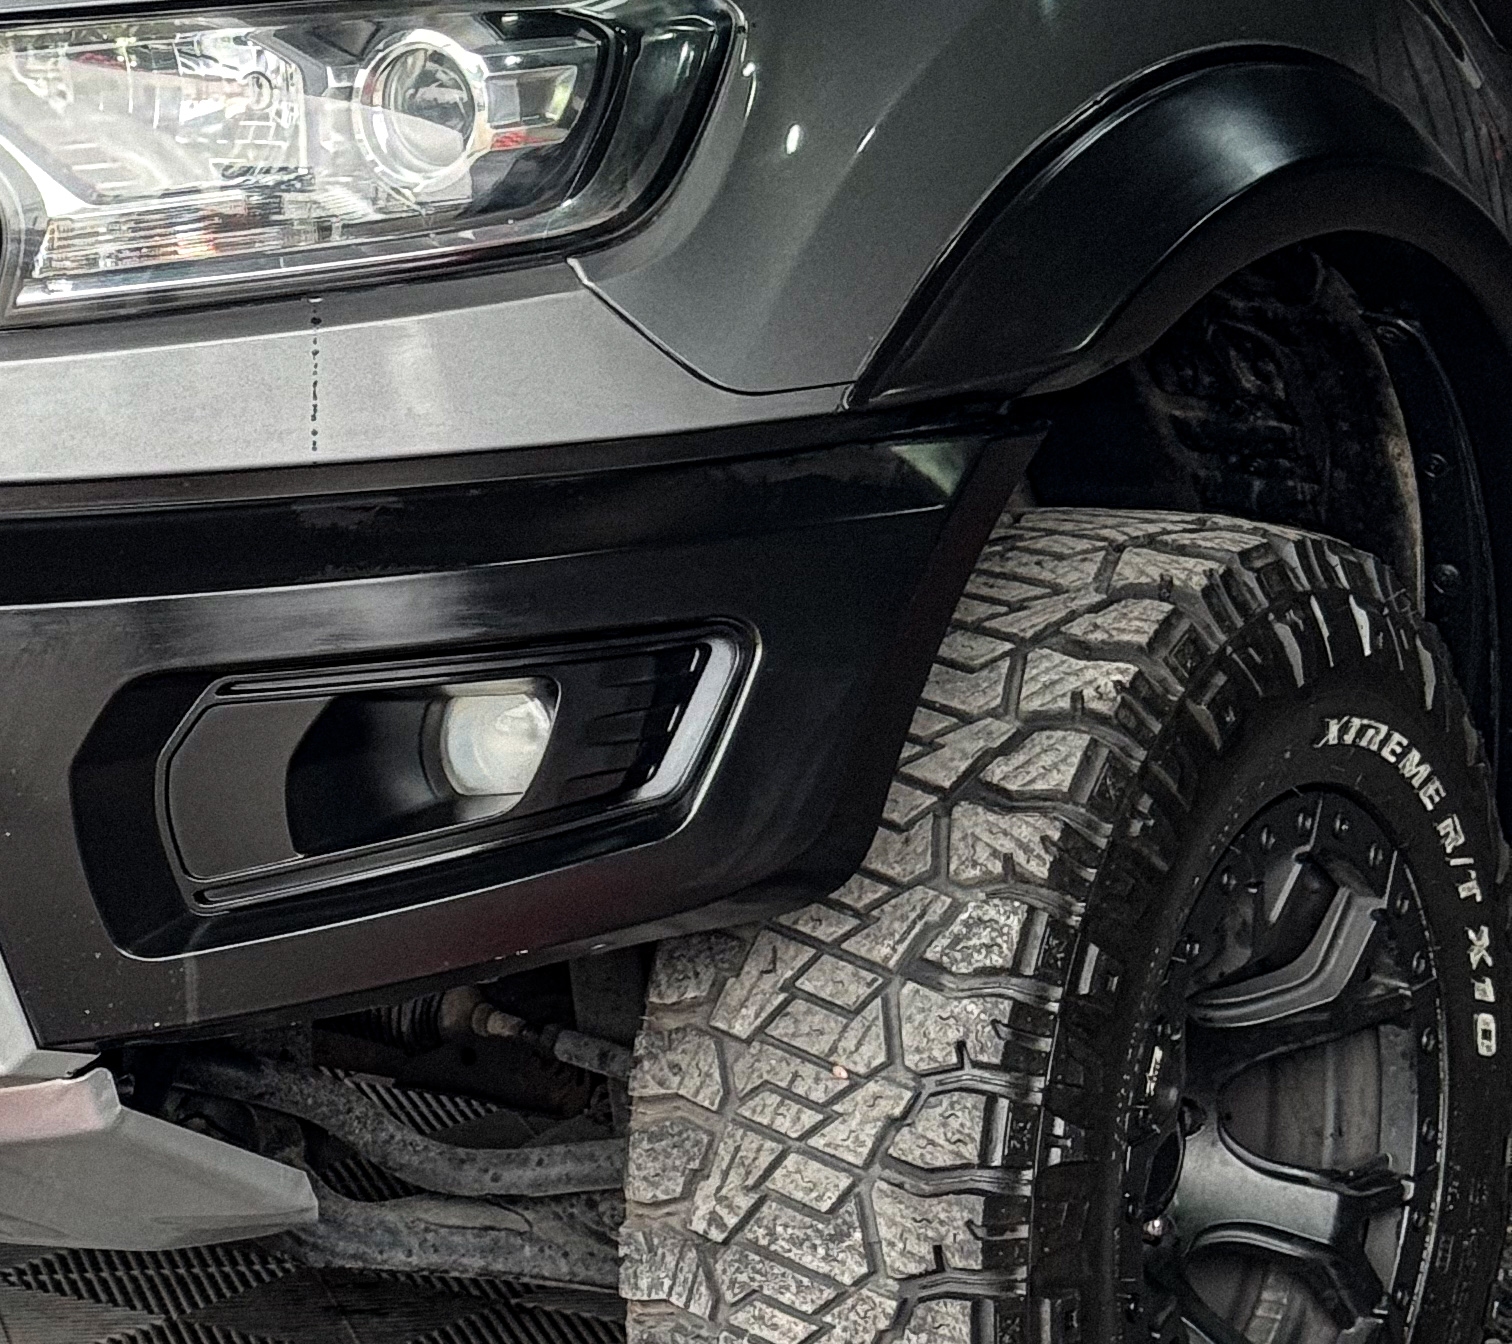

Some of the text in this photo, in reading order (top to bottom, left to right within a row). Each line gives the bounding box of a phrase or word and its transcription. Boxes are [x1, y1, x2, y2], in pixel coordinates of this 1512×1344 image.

[1315, 716, 1497, 1056] XTREME R/T X10
